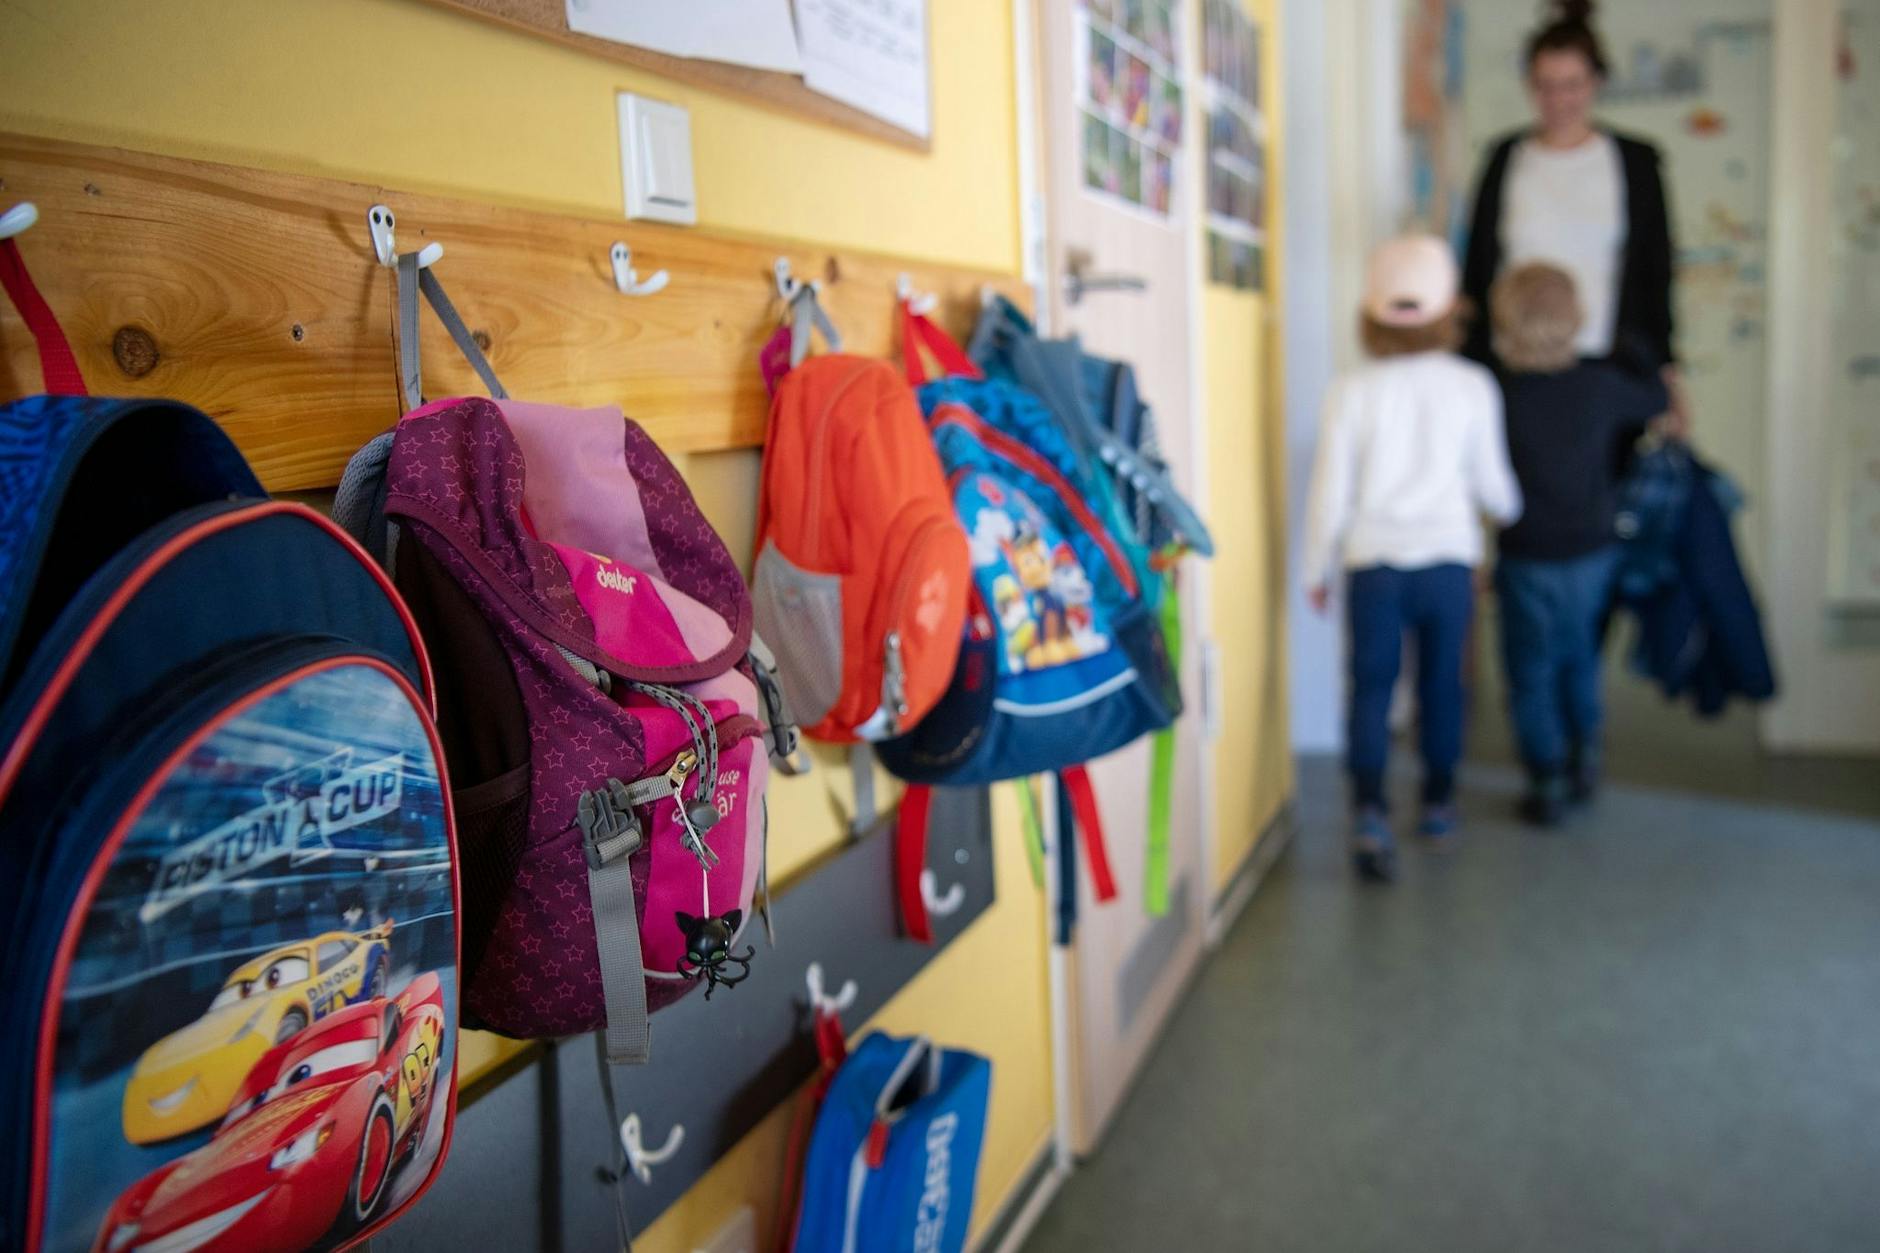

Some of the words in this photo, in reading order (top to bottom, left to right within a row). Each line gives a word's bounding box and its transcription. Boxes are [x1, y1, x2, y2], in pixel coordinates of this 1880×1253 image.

[160, 808, 291, 891] PISTON
[327, 769, 396, 822] CUP
[306, 963, 358, 1000] DINOCO
